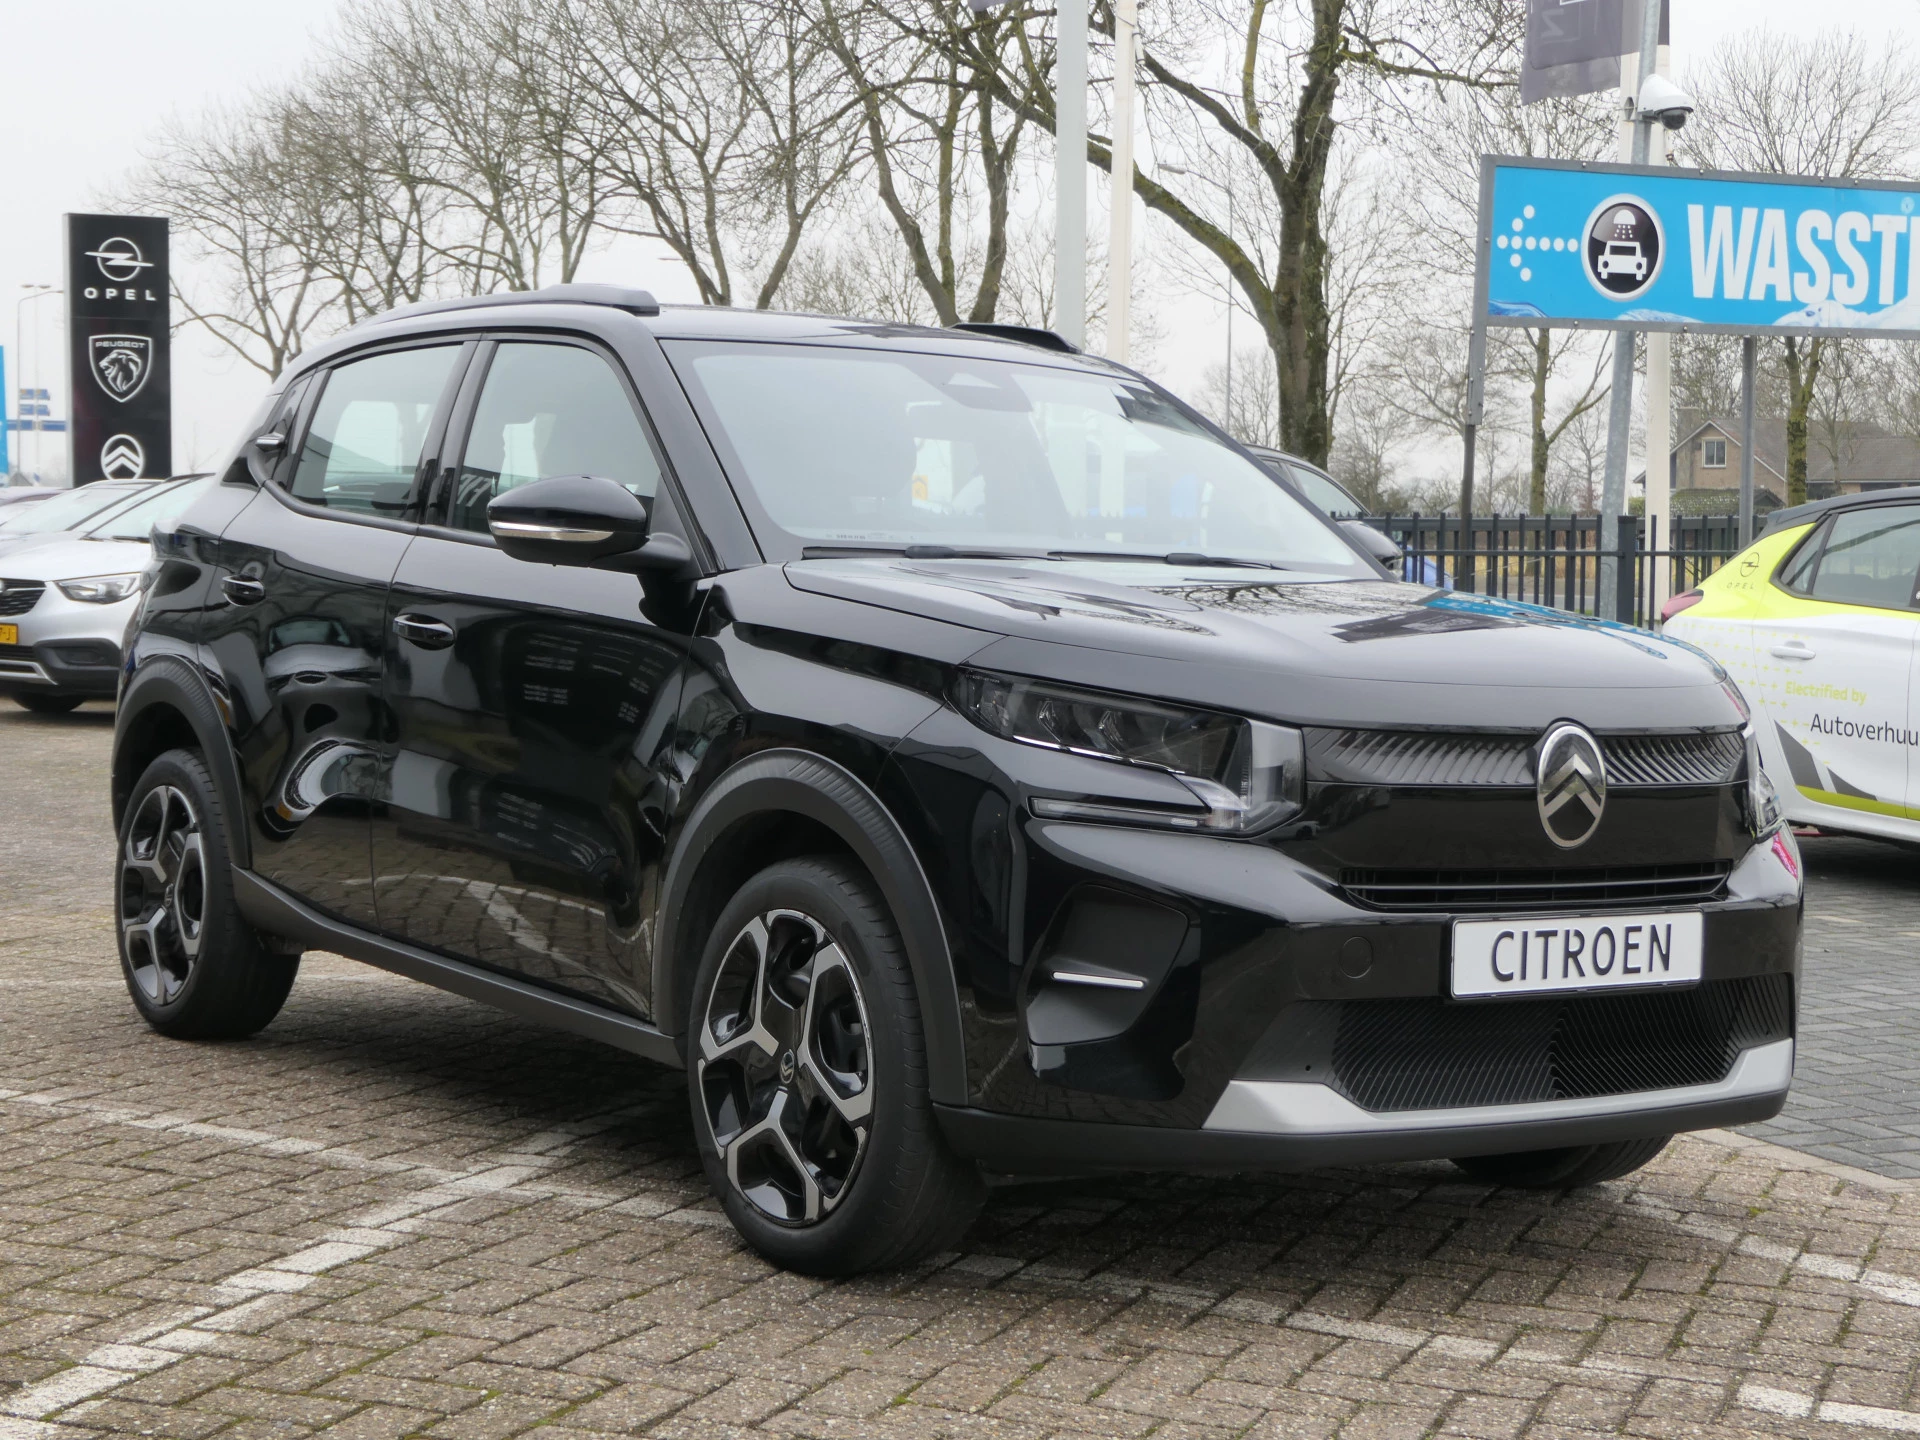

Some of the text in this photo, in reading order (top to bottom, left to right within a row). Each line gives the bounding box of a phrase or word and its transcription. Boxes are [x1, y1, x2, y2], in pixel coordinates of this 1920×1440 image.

[1687, 203, 1920, 306] WASST
[84, 287, 157, 301] OPEL
[95, 340, 146, 349] PEUGEOT
[1726, 582, 1755, 590] OPEL
[1785, 680, 1867, 706] Electrified by
[1810, 713, 1919, 747] Autoverhuu
[1491, 923, 1672, 982] CITROEN
